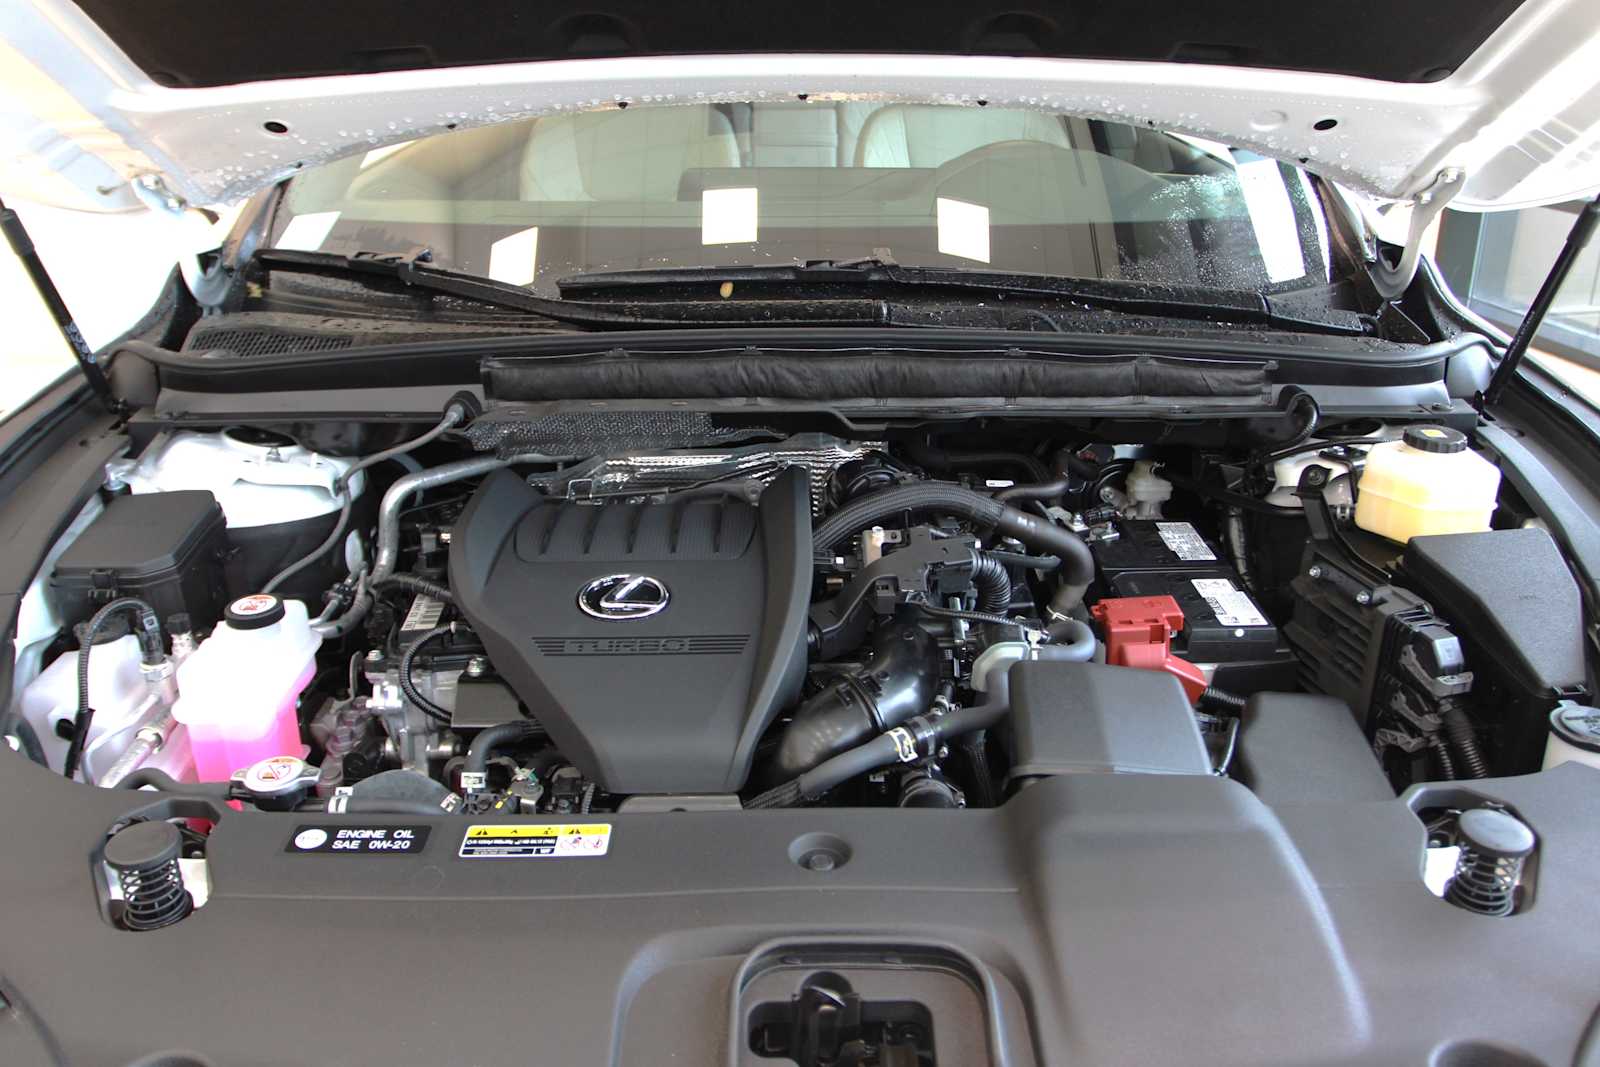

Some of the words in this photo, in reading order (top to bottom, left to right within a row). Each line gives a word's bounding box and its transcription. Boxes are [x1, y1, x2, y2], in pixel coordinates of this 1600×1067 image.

[568, 640, 686, 653] TURBO
[336, 829, 387, 839] ENGINE
[393, 829, 415, 839] OIL
[331, 840, 361, 850] SAE
[368, 840, 411, 850] 0W-20
